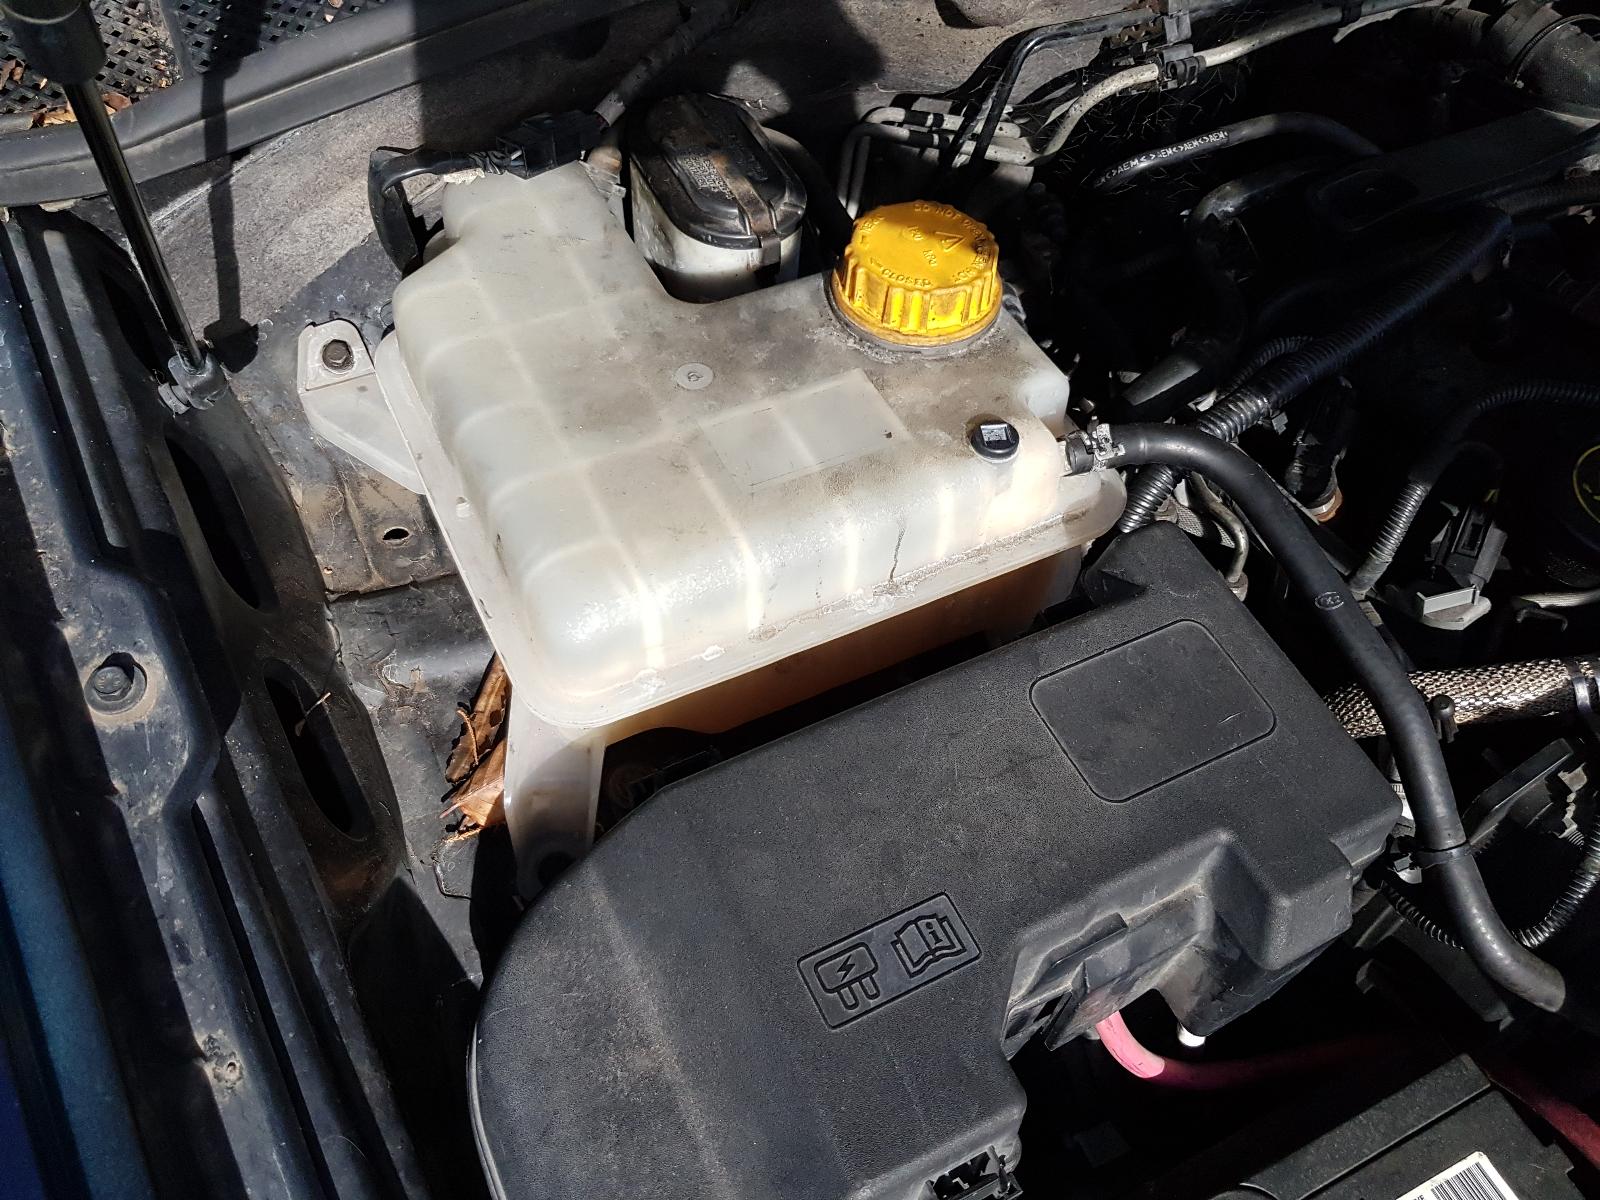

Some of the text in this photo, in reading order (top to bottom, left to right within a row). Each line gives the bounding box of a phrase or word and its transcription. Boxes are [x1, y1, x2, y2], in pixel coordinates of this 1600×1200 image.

[914, 202, 931, 213] DO
[935, 206, 961, 220] NOT
[881, 268, 931, 287] CLOSED
